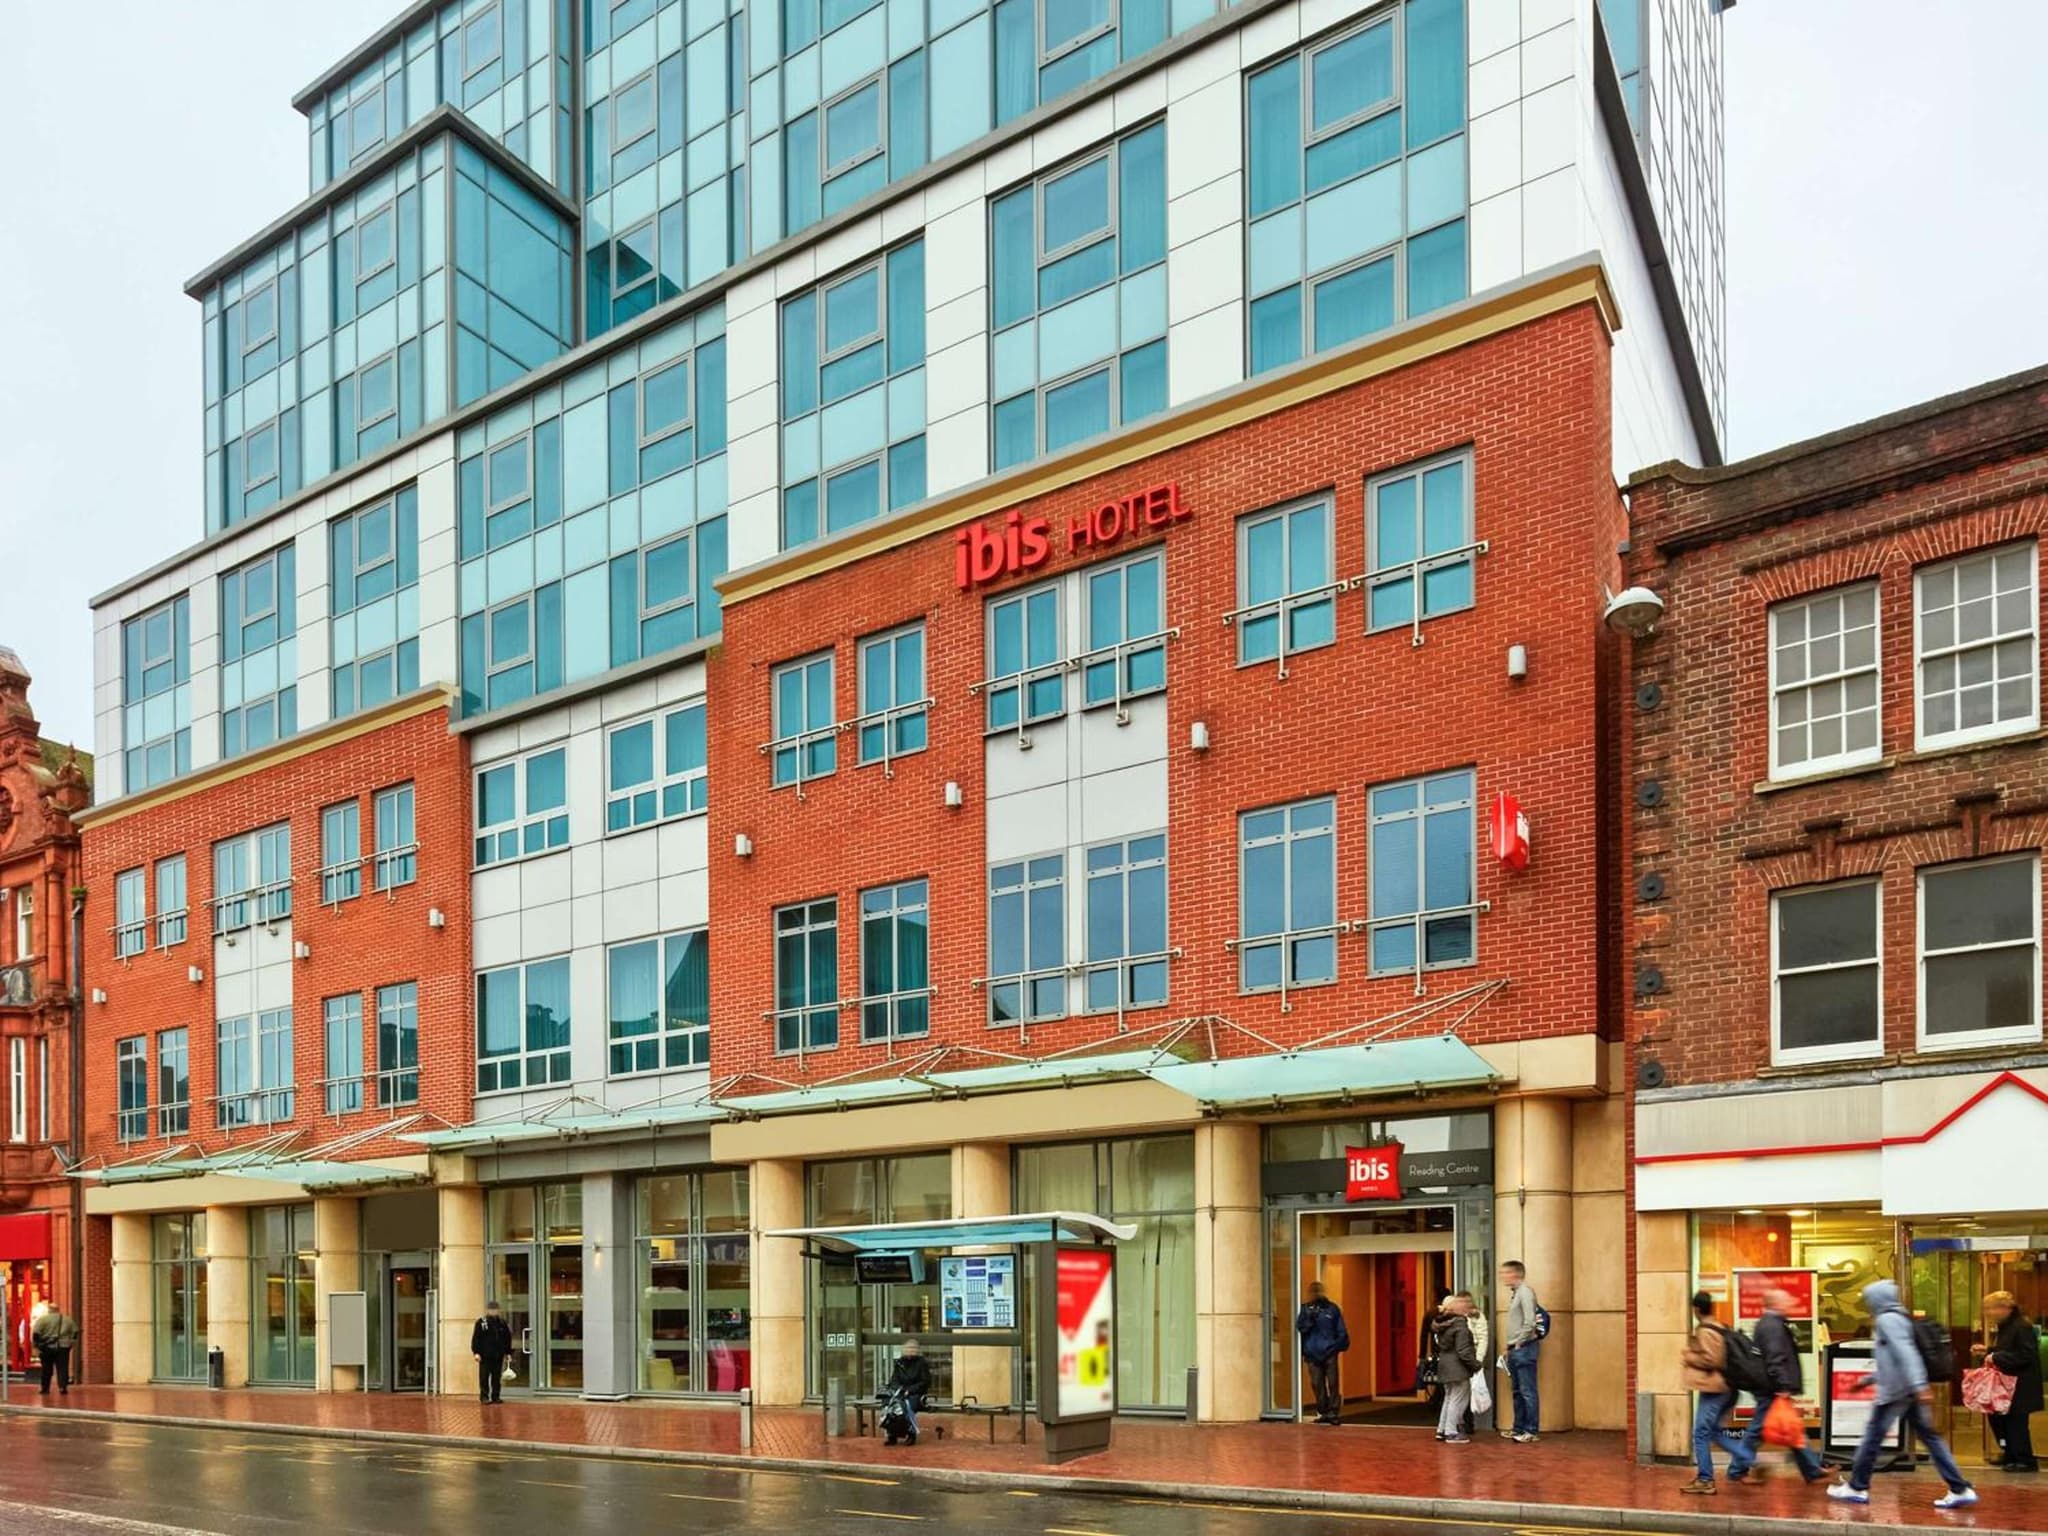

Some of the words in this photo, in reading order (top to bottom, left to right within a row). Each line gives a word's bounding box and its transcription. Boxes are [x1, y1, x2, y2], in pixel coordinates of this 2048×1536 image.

[955, 509, 1049, 590] ibis
[1067, 479, 1193, 555] HOTEL
[1349, 1158, 1390, 1182] ibis
[1408, 1164, 1445, 1177] Reading
[1446, 1162, 1480, 1174] Centre
